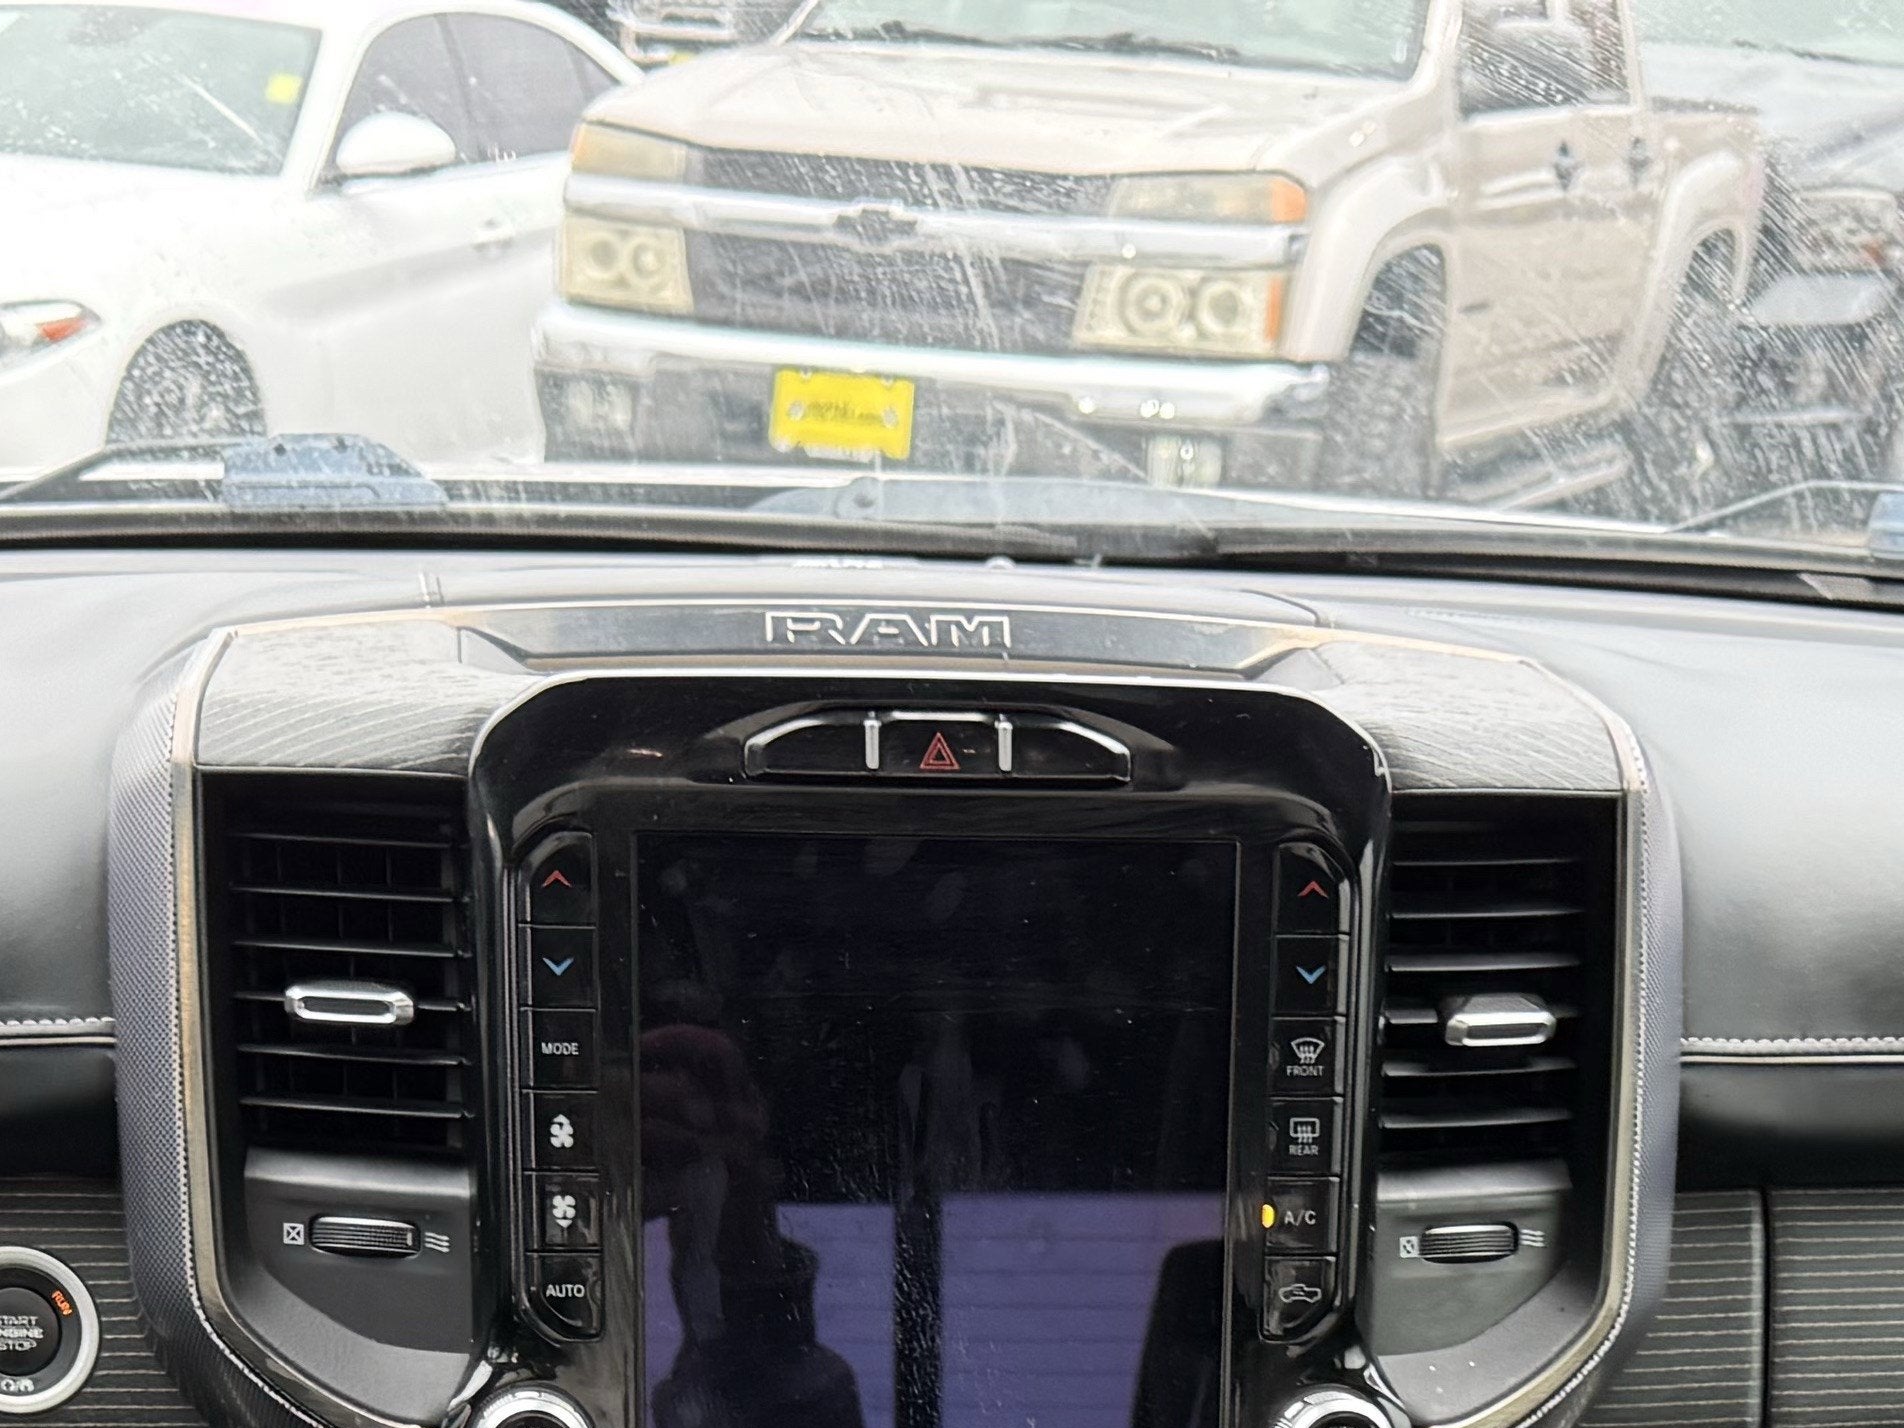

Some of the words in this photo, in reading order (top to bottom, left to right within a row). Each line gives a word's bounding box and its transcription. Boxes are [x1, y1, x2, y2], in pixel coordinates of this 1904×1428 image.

[765, 611, 1011, 648] RAM
[541, 1042, 579, 1055] MODE
[1287, 1065, 1325, 1077] FRONT
[1289, 1145, 1319, 1156] REAR
[1284, 1210, 1317, 1225] A/C
[546, 1284, 585, 1298] AUTO
